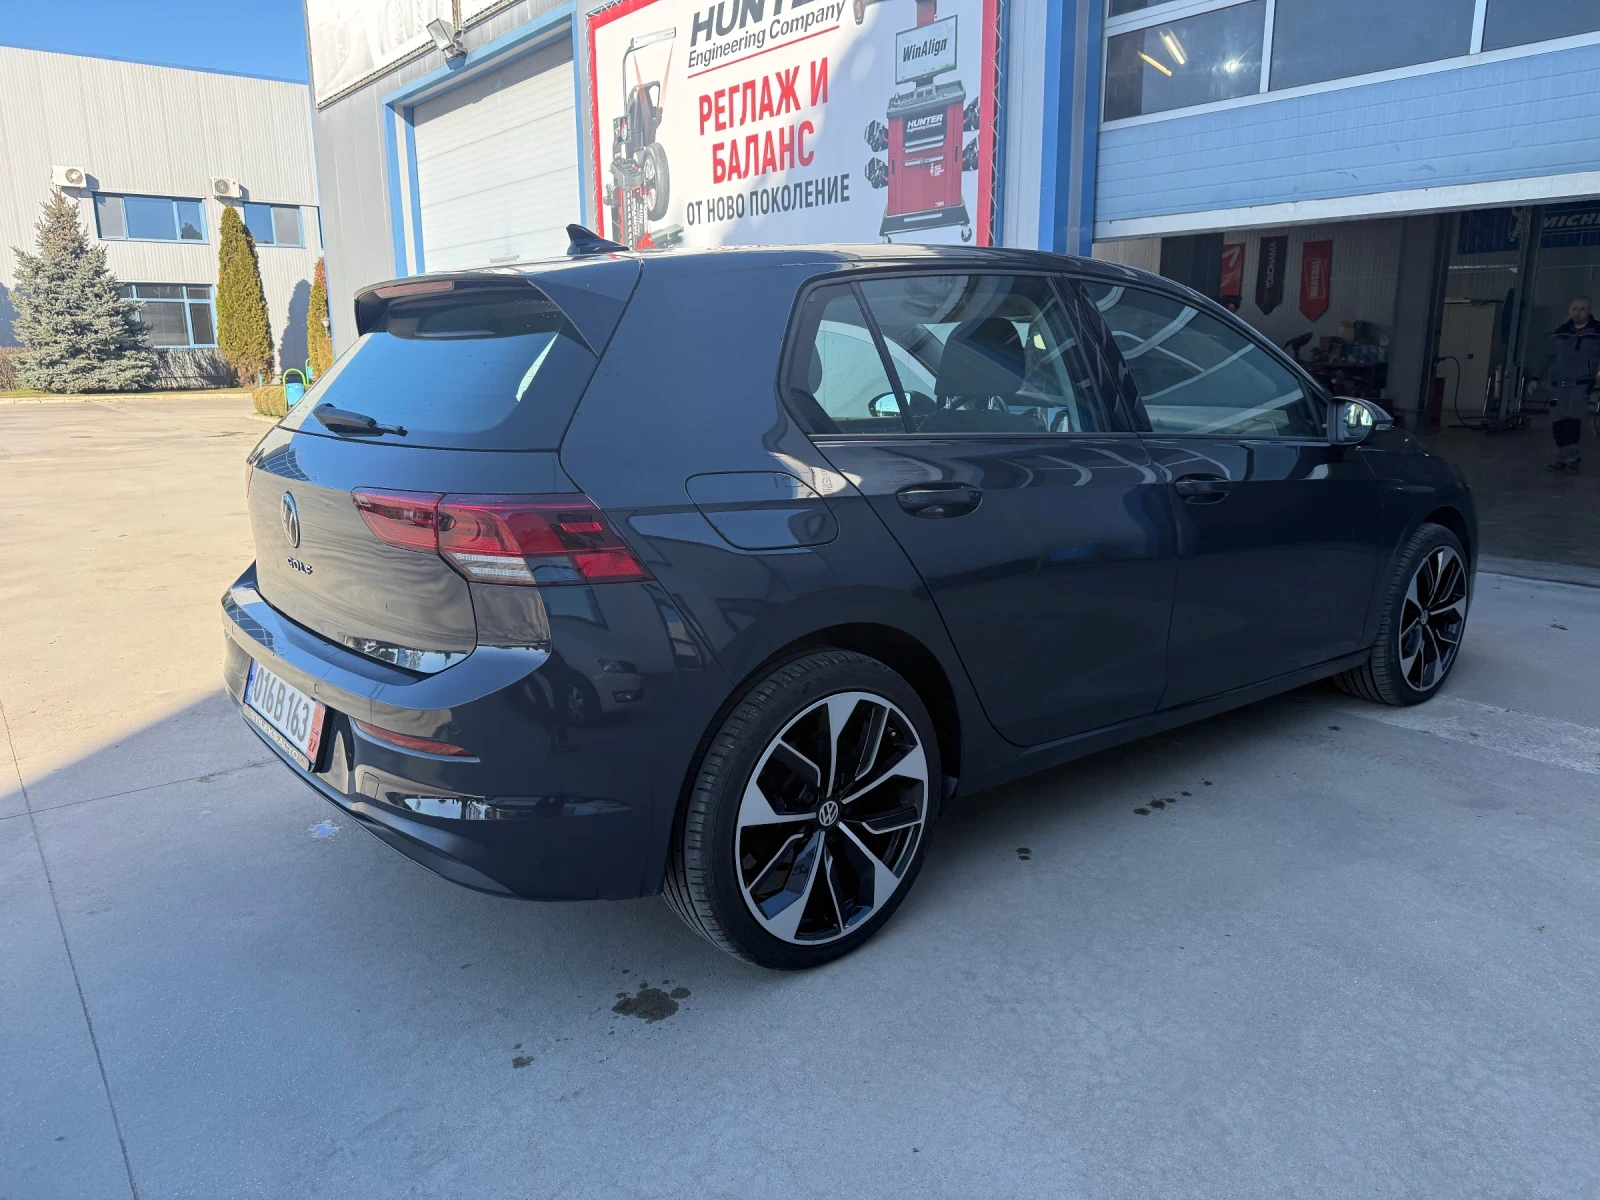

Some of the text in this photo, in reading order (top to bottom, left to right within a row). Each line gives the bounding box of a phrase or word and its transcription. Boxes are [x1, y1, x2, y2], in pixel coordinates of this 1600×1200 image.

[688, 0, 846, 69] Engineering Company
[903, 37, 948, 62] WinAlign
[699, 56, 829, 136] РЕГЛАЖ И
[907, 113, 943, 129] HUNTER
[712, 120, 815, 184] БАЛАНС
[686, 173, 850, 226] ОТ НОВО ПОКОЛЕНИЕ
[1265, 241, 1277, 289] YOKOHAMA
[1309, 260, 1321, 298] MARSHAL
[278, 737, 299, 760] AUTO
